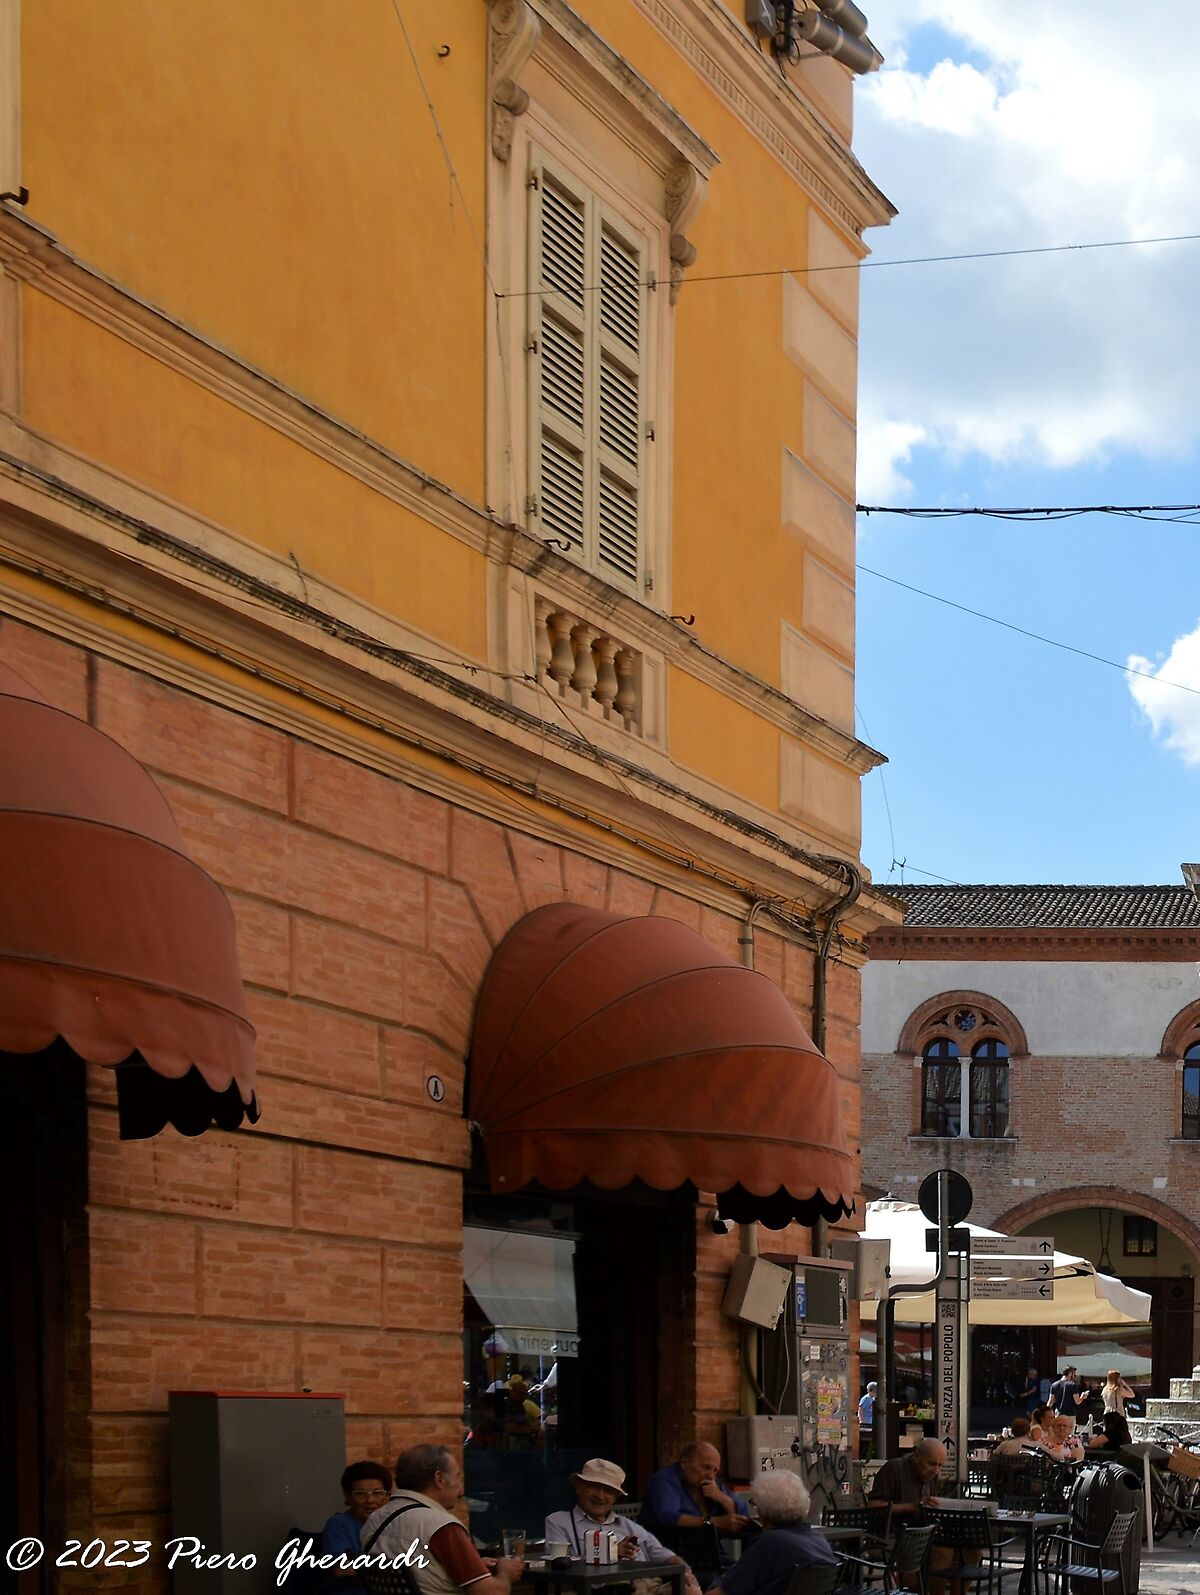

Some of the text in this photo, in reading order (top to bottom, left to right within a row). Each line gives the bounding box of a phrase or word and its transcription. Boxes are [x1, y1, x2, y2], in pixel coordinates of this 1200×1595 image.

[943, 1324, 954, 1363] POPOLO
[943, 1365, 953, 1383] DEL
[943, 1385, 953, 1418] PIAZZA
